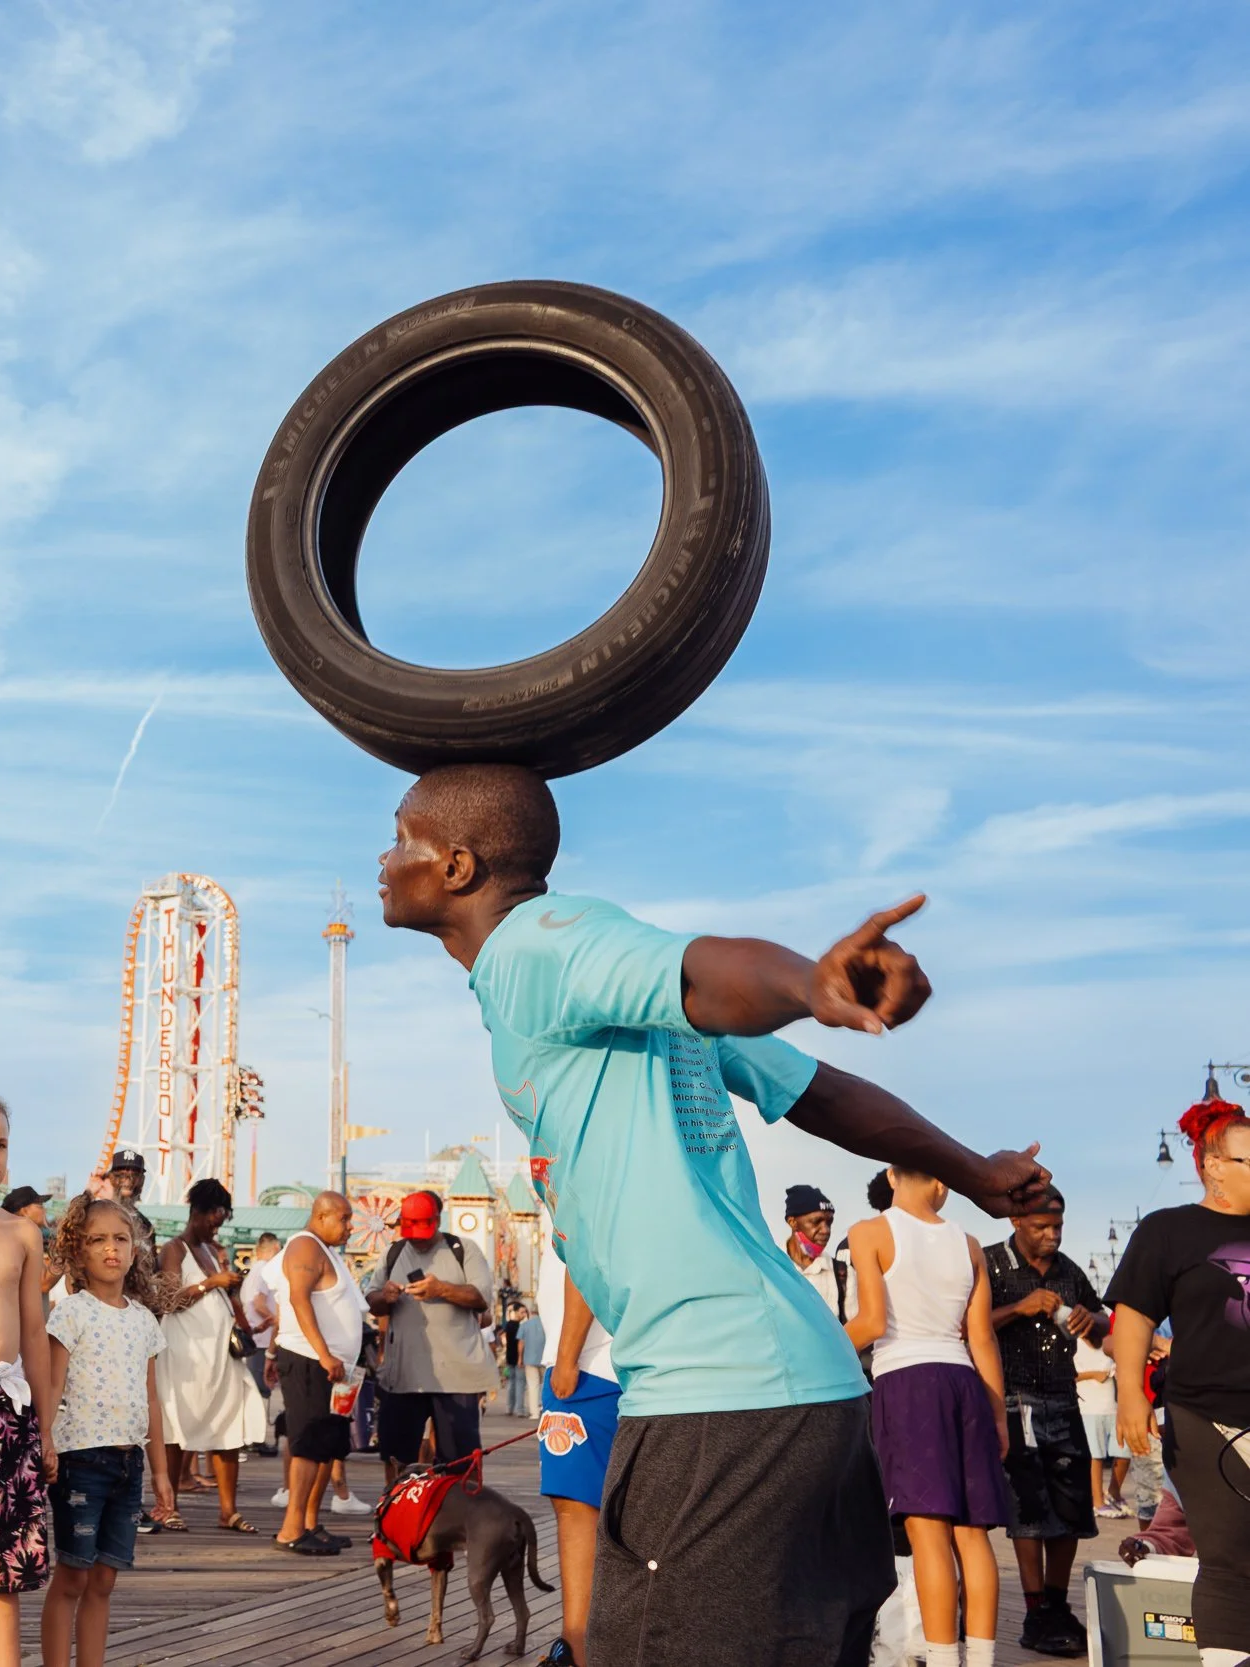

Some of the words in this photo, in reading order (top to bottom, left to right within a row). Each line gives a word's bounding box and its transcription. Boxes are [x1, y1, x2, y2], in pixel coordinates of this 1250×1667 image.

[282, 342, 381, 454] MICHELIN
[580, 548, 694, 675] MICHELIN
[159, 907, 175, 1176] THUNDERBOLT
[691, 1119, 704, 1127] his
[1159, 1614, 1186, 1624] IGLOO
